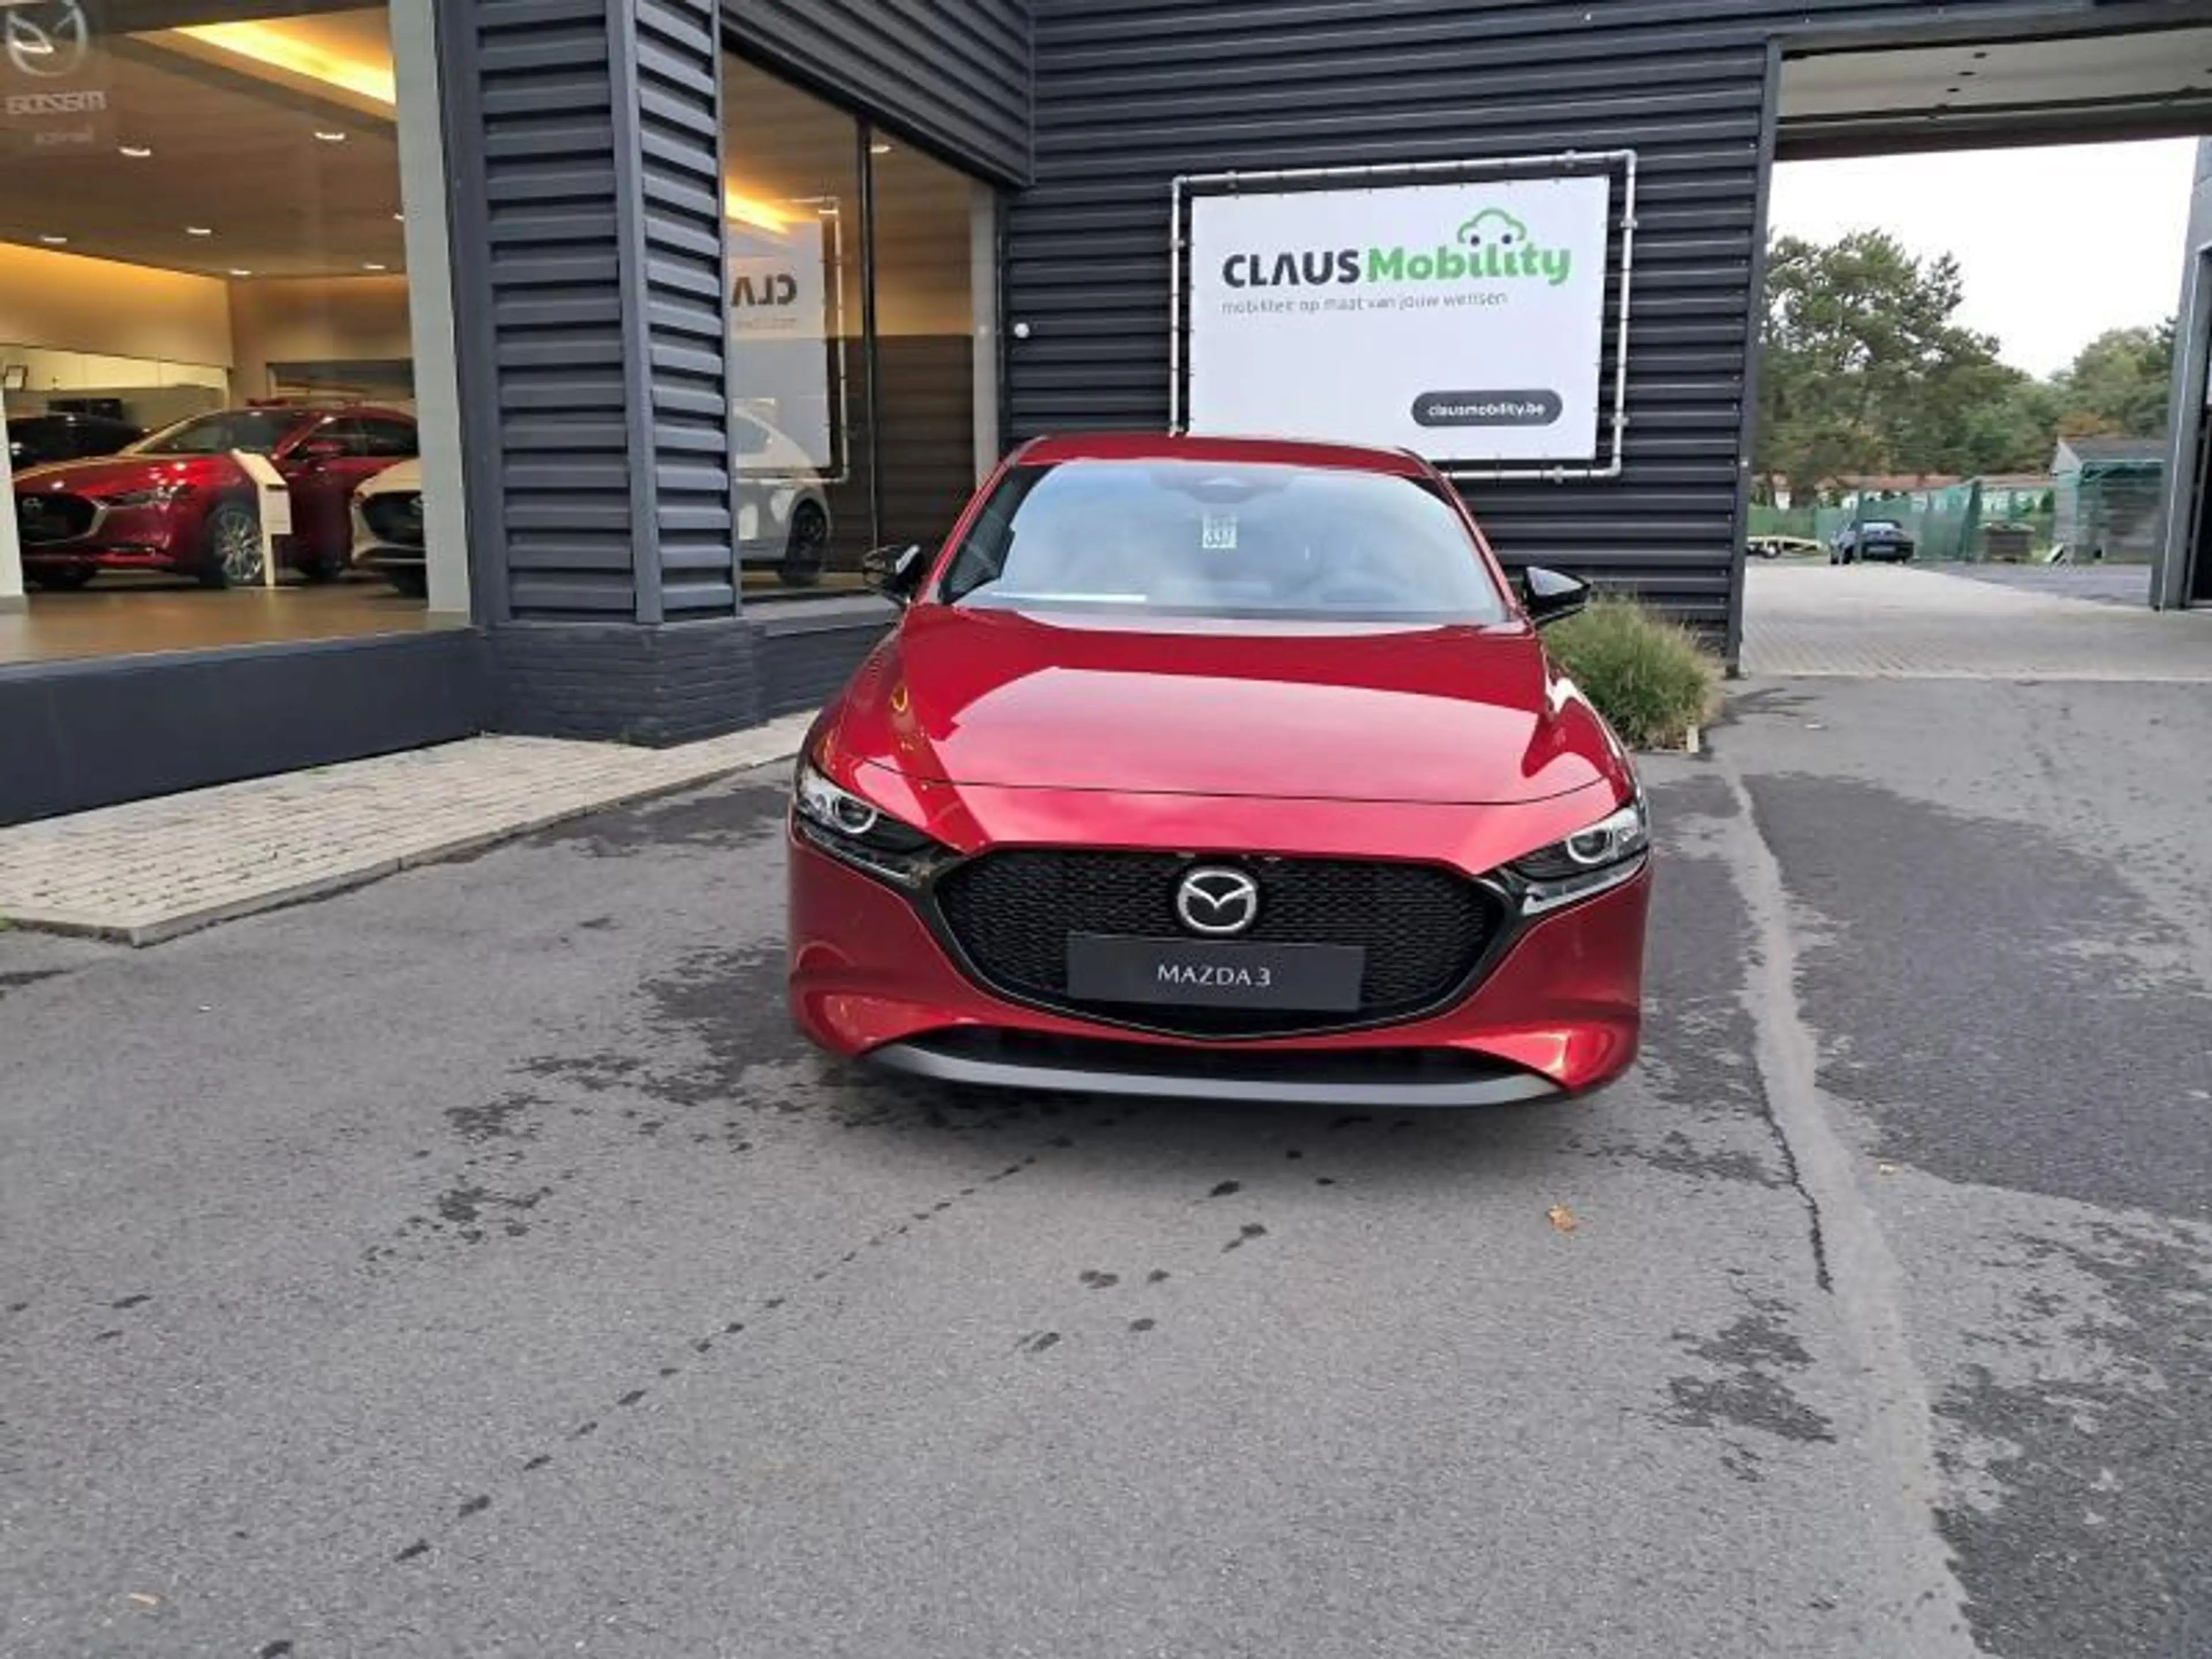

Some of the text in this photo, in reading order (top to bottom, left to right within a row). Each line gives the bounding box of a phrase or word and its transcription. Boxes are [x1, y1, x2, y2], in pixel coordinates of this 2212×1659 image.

[1222, 242, 1571, 288] CLAUS Mobility
[1299, 298, 1320, 315] op
[1158, 964, 1271, 986] MAZDA 3
